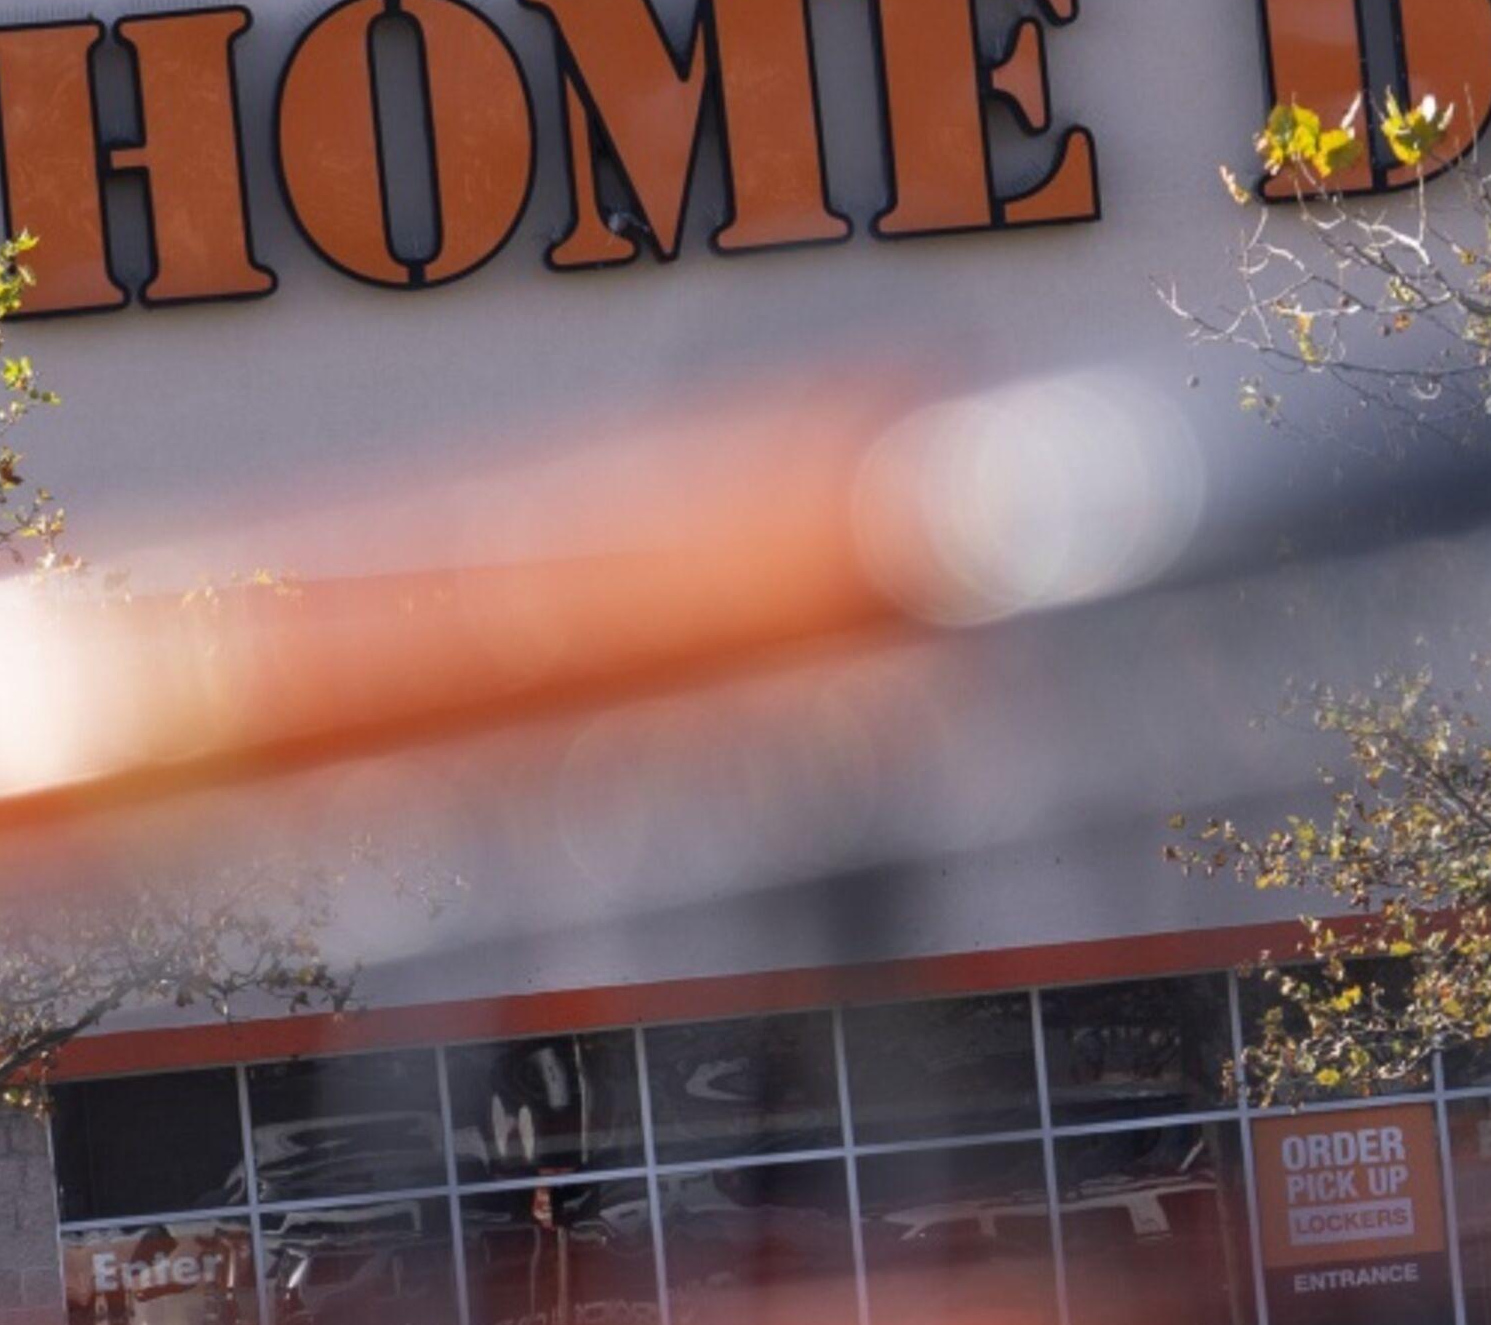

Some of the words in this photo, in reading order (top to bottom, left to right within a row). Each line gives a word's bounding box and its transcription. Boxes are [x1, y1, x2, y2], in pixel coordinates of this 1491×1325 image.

[1282, 1126, 1407, 1171] ORDER
[1285, 1170, 1358, 1204] PICK
[1366, 1165, 1408, 1197] UP
[1294, 1206, 1409, 1236] LOCKERS
[92, 1252, 224, 1292] Enter
[1294, 1263, 1420, 1294] ENTRANCE
